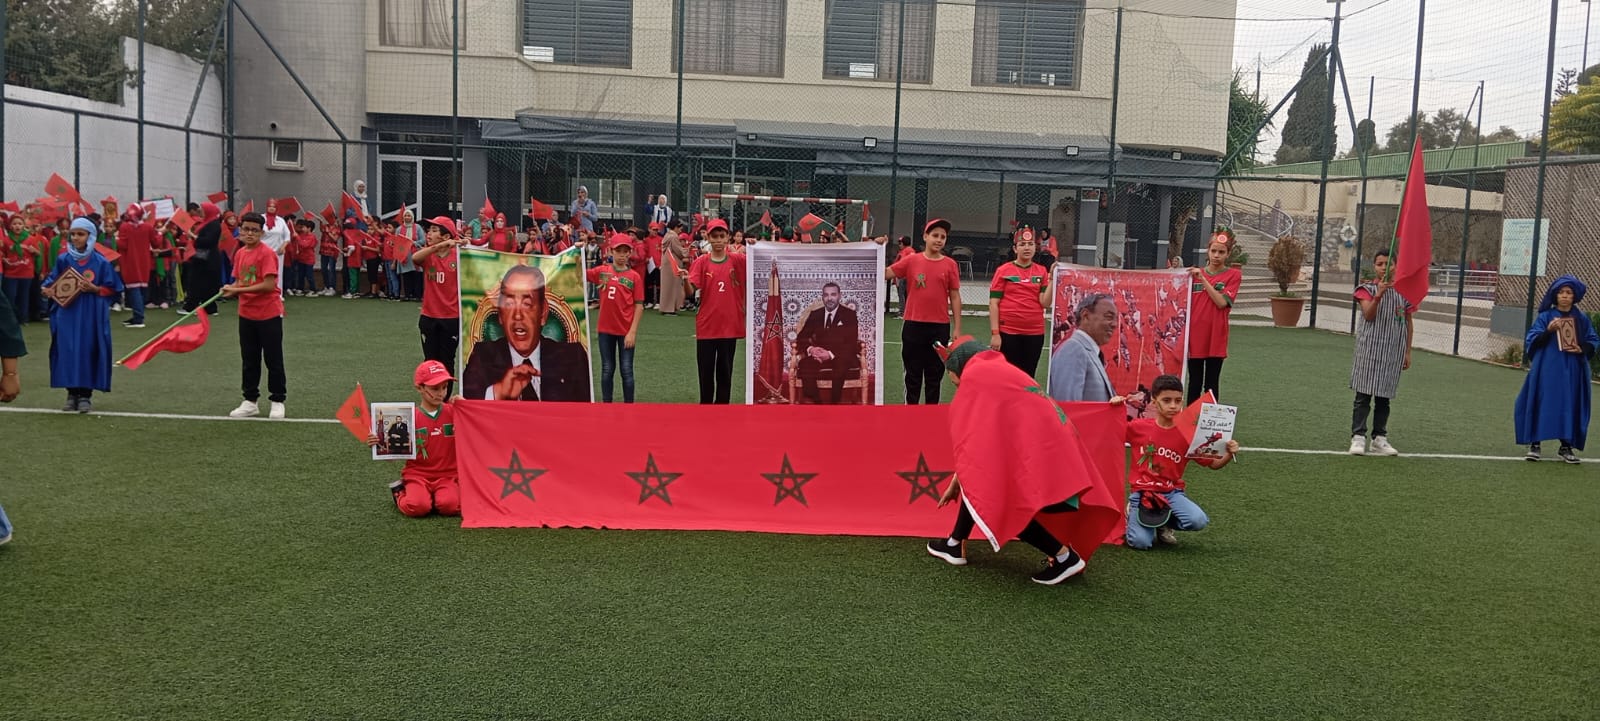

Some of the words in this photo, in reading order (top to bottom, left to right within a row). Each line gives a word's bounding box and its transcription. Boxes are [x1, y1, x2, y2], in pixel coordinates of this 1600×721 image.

[437, 272, 445, 284] 10
[608, 286, 616, 300] 2
[718, 281, 726, 292] 2
[1140, 446, 1182, 464] OCCO
